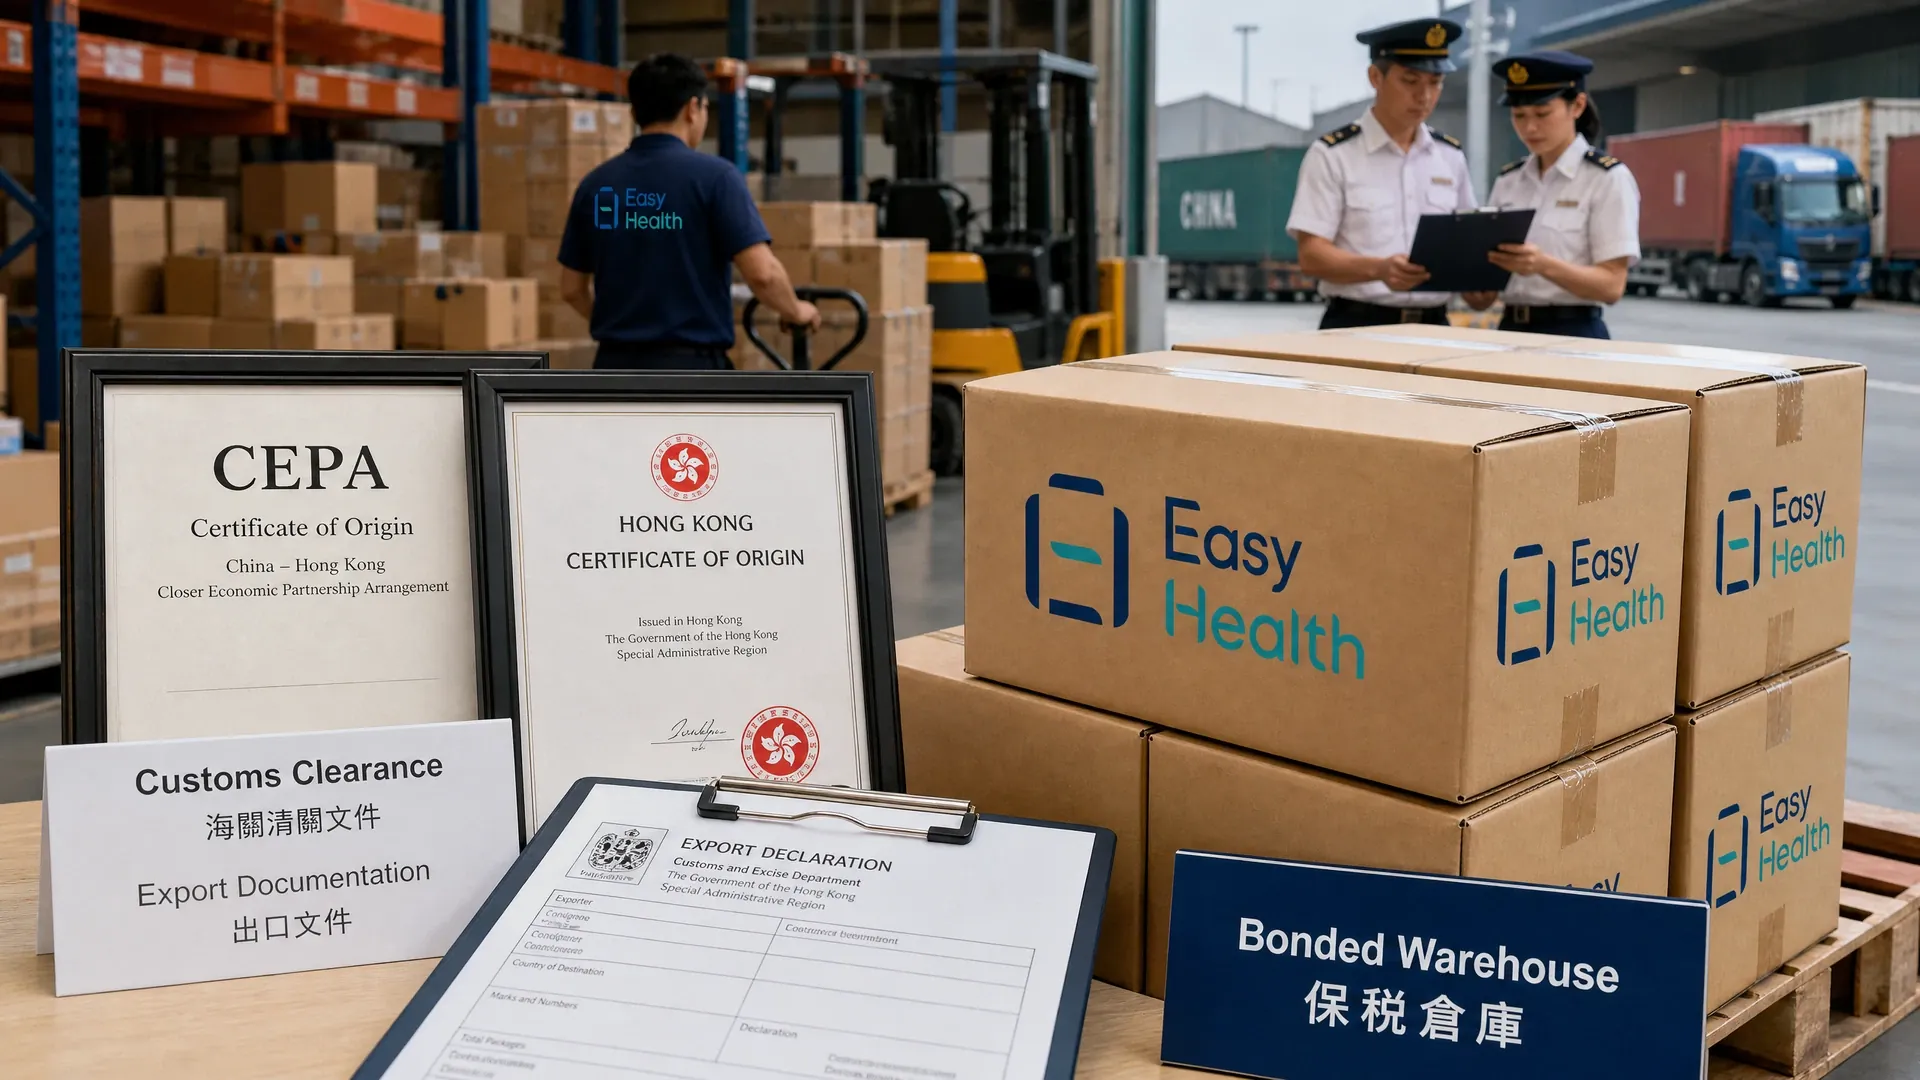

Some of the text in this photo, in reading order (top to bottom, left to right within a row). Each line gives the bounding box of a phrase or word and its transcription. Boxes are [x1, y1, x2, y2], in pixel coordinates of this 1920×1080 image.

[626, 188, 666, 210] Easy
[626, 212, 682, 229] Health
[213, 444, 390, 491] CEPA
[1773, 486, 1826, 528] Easy
[190, 517, 414, 541] Certificate of Origin
[619, 514, 754, 533] HONG KONG
[566, 549, 805, 570] CERTIFICATE OF ORIGIN
[1165, 496, 1302, 593] Easy
[1772, 526, 1845, 578] Health
[225, 558, 275, 574] China
[295, 558, 339, 576] Hong
[343, 557, 386, 575] Kong
[1571, 538, 1640, 587] Easy
[157, 580, 449, 599] Closer Economic Partnership Arrangement
[638, 614, 742, 628] Issued in Hong Kong
[1165, 579, 1364, 679] Health
[1570, 583, 1664, 645] Health
[605, 629, 779, 644] The Government of the Hong Kong
[617, 645, 767, 662] Special Administrative Region
[135, 756, 444, 796] Customs Clearance
[205, 802, 381, 841] 海關清關文件
[1760, 785, 1812, 834] Easy
[681, 838, 892, 872] EXPORT DECLARATION
[1759, 818, 1830, 882] Health
[138, 861, 431, 909] Export Documentation
[668, 871, 856, 902] The Government of the Hong Kong
[673, 857, 861, 887] Customs and Excise Department
[555, 895, 593, 906] Exporter
[660, 883, 825, 910] Special Administrative Region
[232, 907, 352, 944] 出口文件
[512, 958, 604, 976] Country of Destination
[1238, 917, 1620, 993] Bonded Warehouse
[490, 991, 578, 1010] Marks and Numbers
[1304, 979, 1524, 1049] 保税倉庫
[740, 1022, 797, 1039] Declaration
